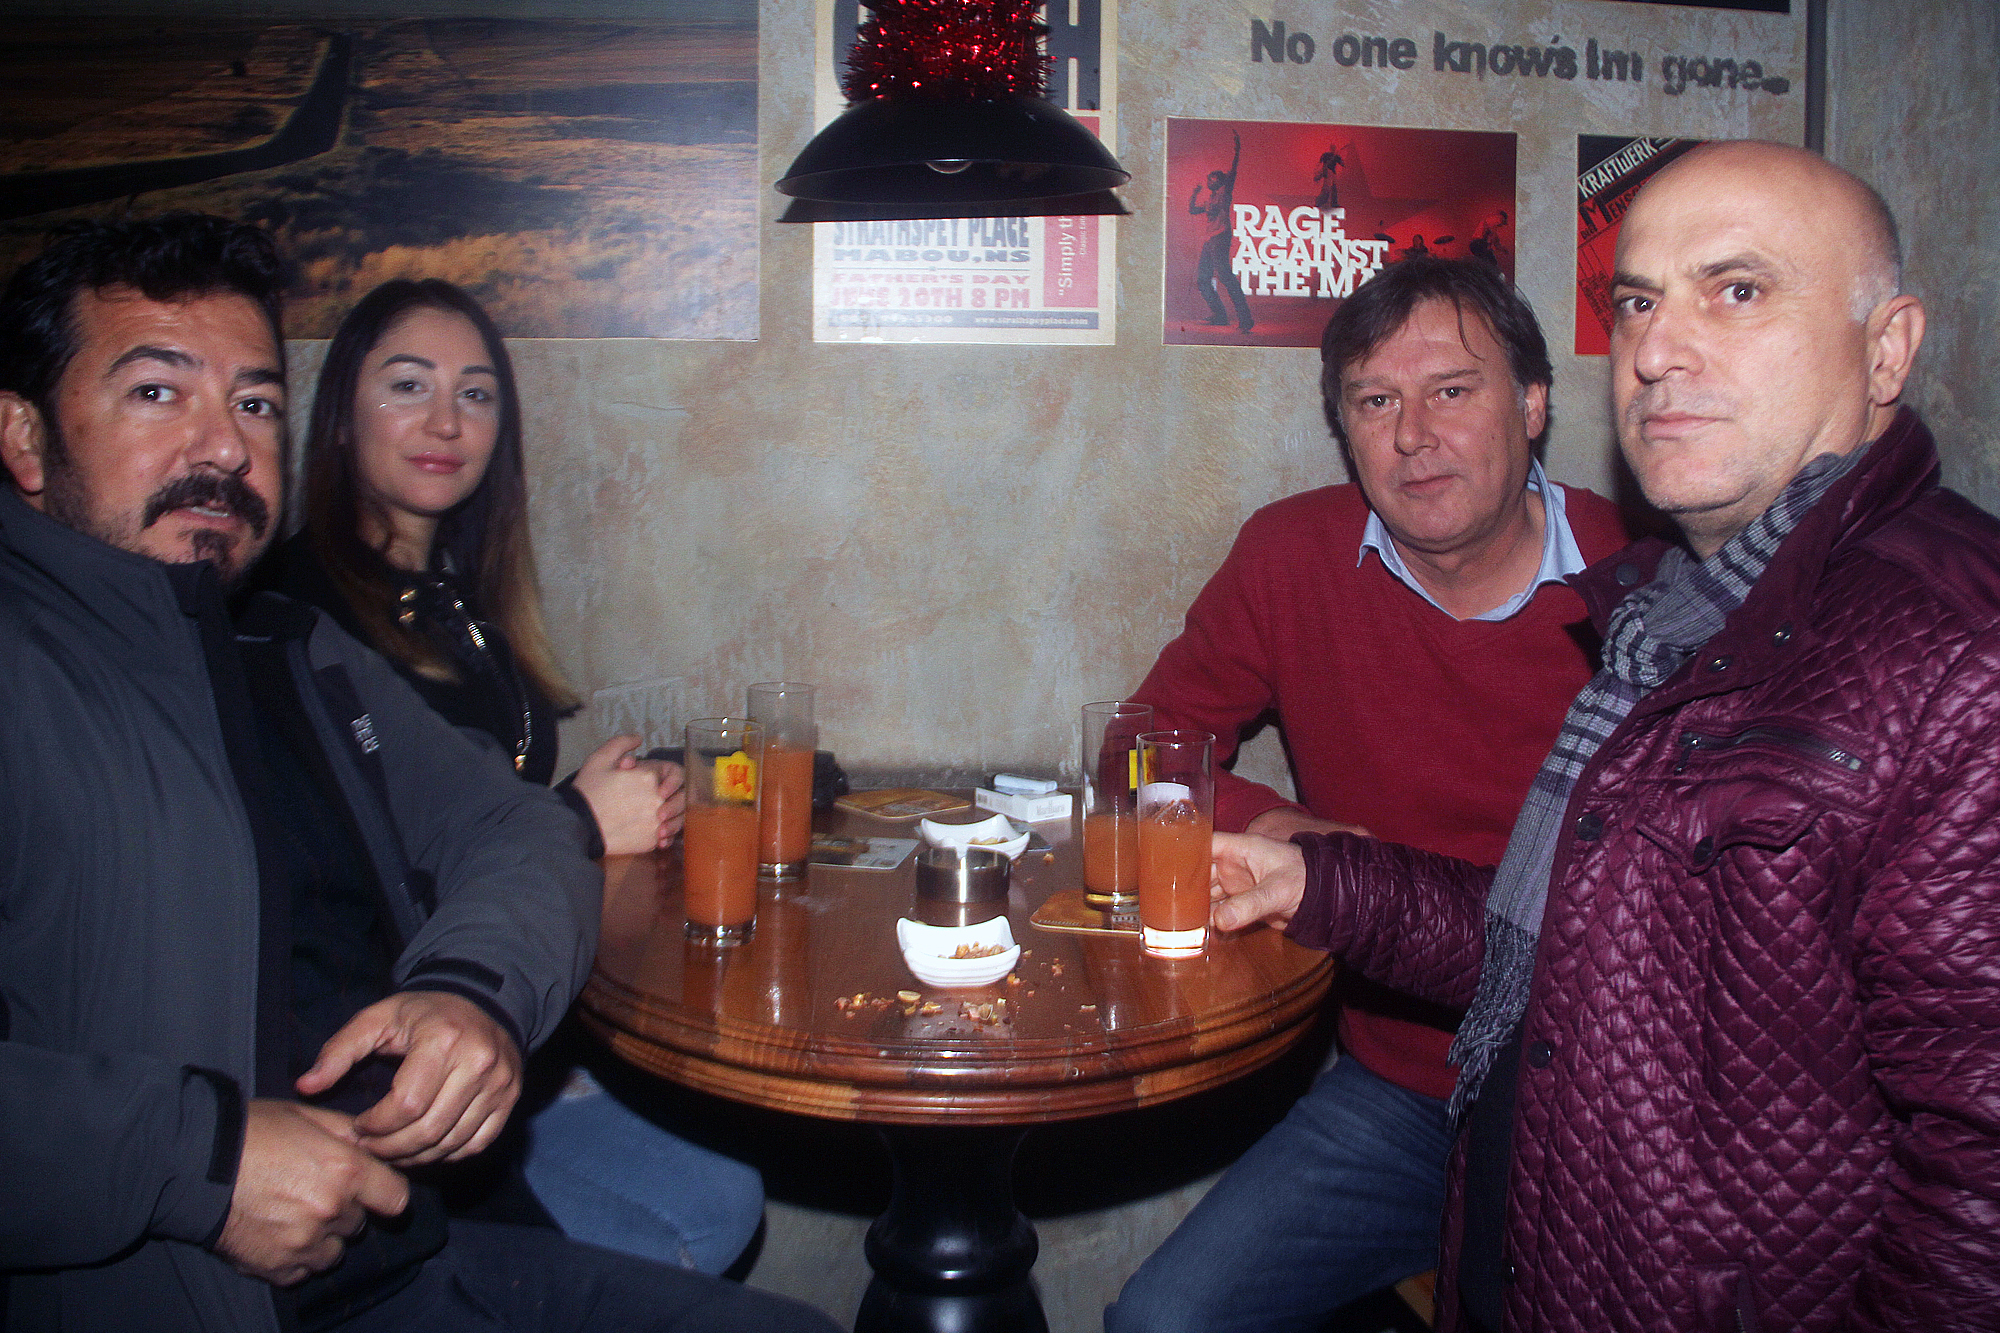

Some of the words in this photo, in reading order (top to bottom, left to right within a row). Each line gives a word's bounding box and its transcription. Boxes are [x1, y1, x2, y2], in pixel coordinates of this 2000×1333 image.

[1250, 18, 1315, 65] No
[1332, 33, 1418, 70] one
[1577, 136, 1659, 200] KRAFTWERK
[967, 215, 1030, 248] PLACE
[1232, 203, 1346, 241] RAGE
[1235, 234, 1389, 270] AGAINST
[831, 273, 964, 284] FATHER'S
[971, 274, 1031, 285] DAY
[1231, 257, 1311, 297] THE
[970, 288, 987, 308] 8
[994, 288, 1031, 309] PM
